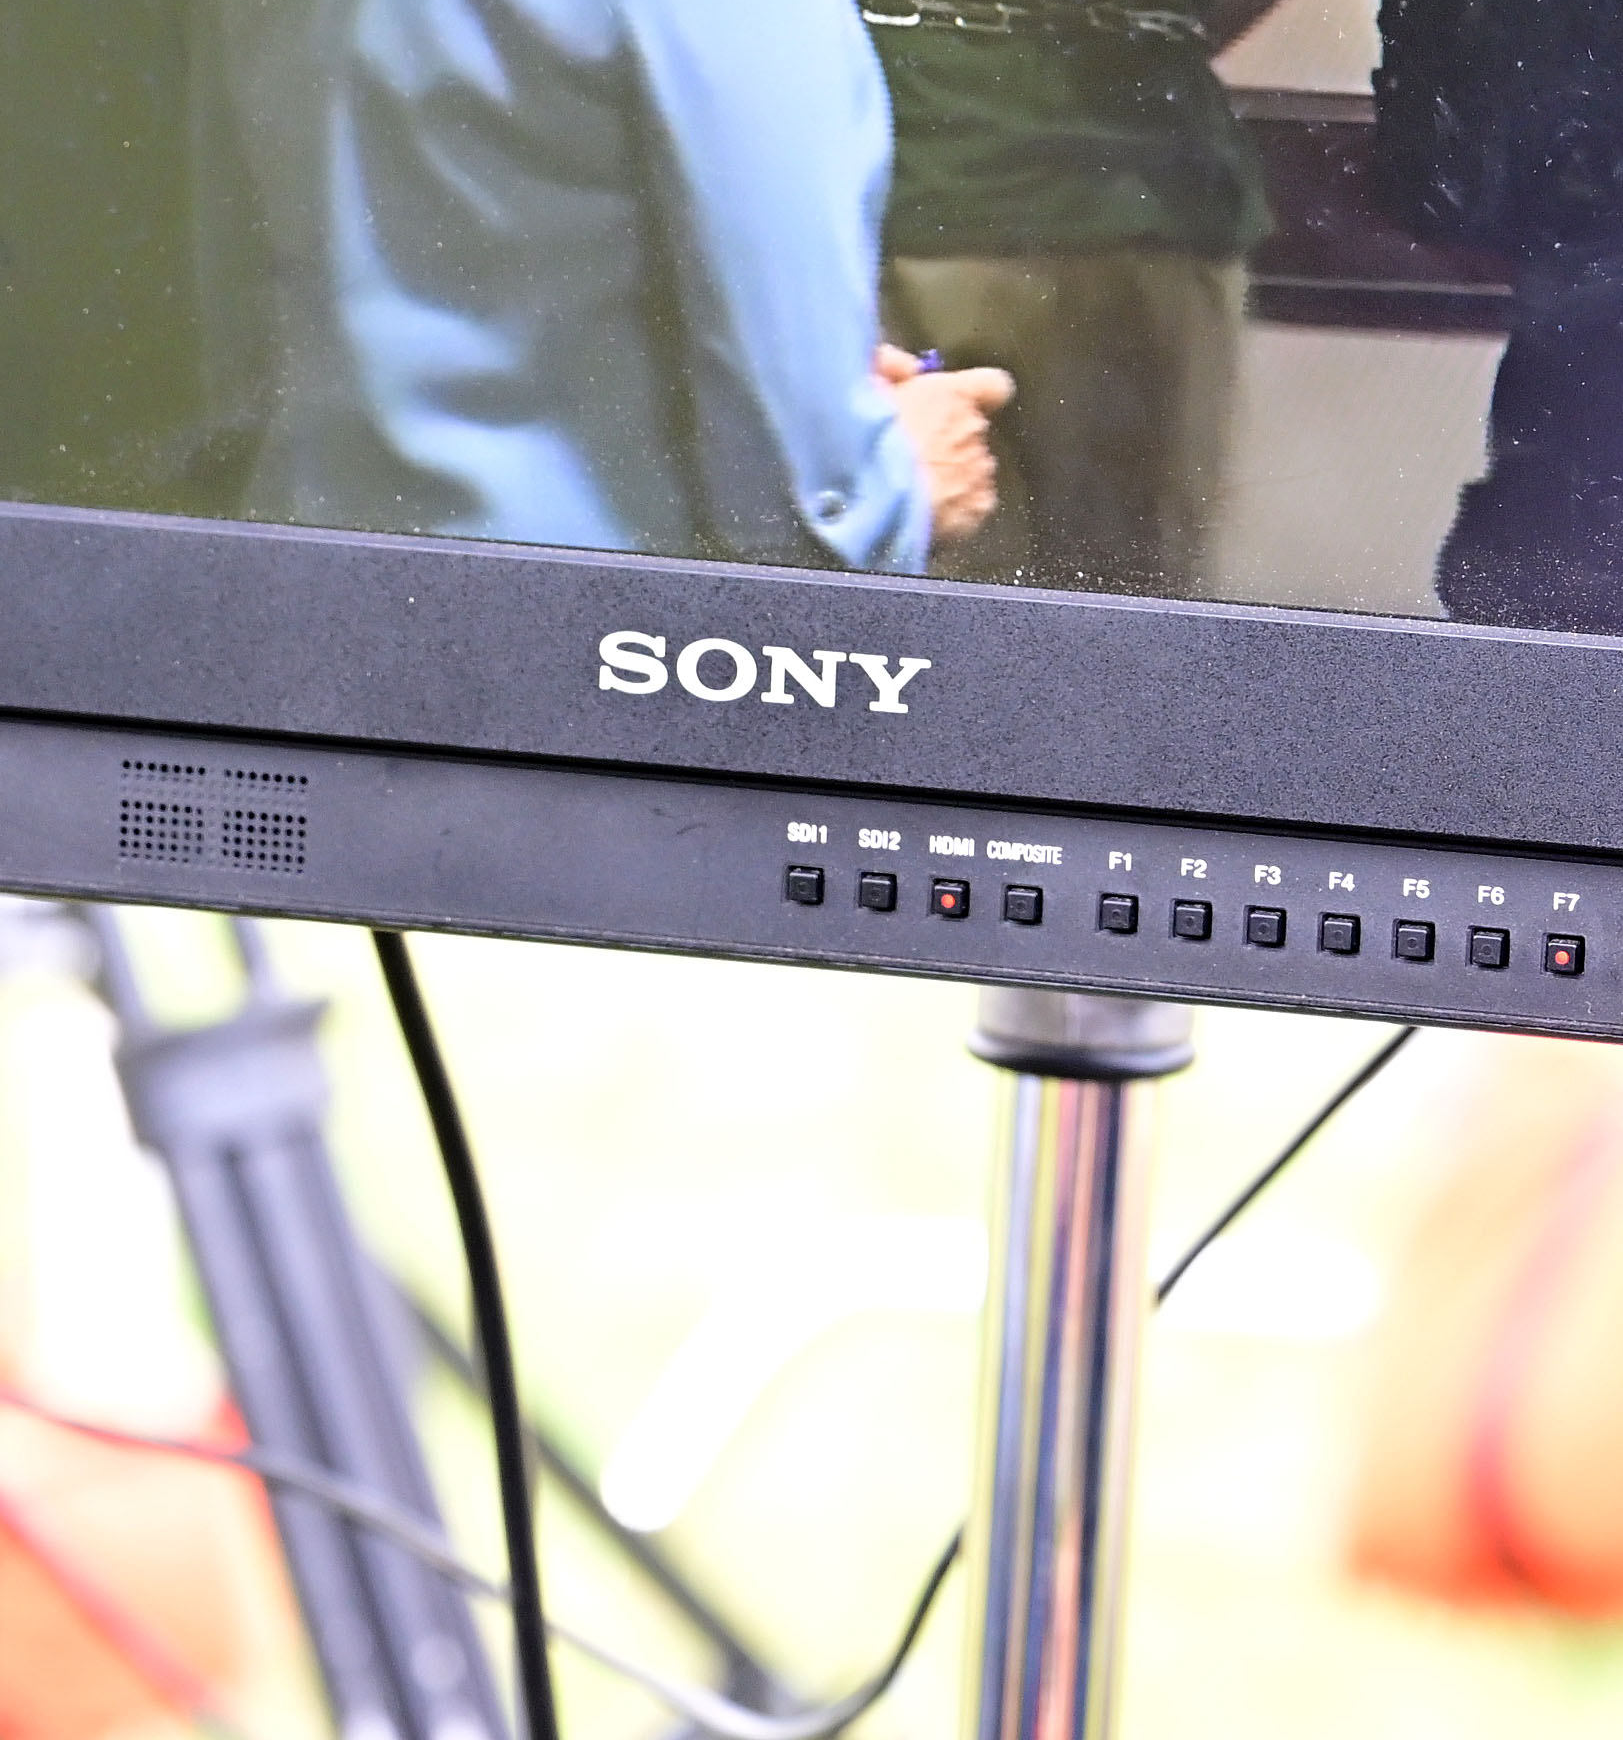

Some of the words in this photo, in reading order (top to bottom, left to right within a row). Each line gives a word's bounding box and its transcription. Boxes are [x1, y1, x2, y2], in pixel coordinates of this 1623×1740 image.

[598, 630, 932, 714] SONY
[787, 822, 827, 844] SDI1
[858, 828, 902, 851] SDI2
[929, 835, 975, 857] HDMI
[986, 840, 1063, 865] COMPOSITE
[1108, 851, 1132, 872] F1
[1180, 858, 1208, 879] F2
[1254, 864, 1282, 885] F3
[1328, 871, 1355, 892] F4
[1402, 878, 1430, 899] F5
[1477, 885, 1505, 905] F6
[1552, 892, 1581, 911] F7
